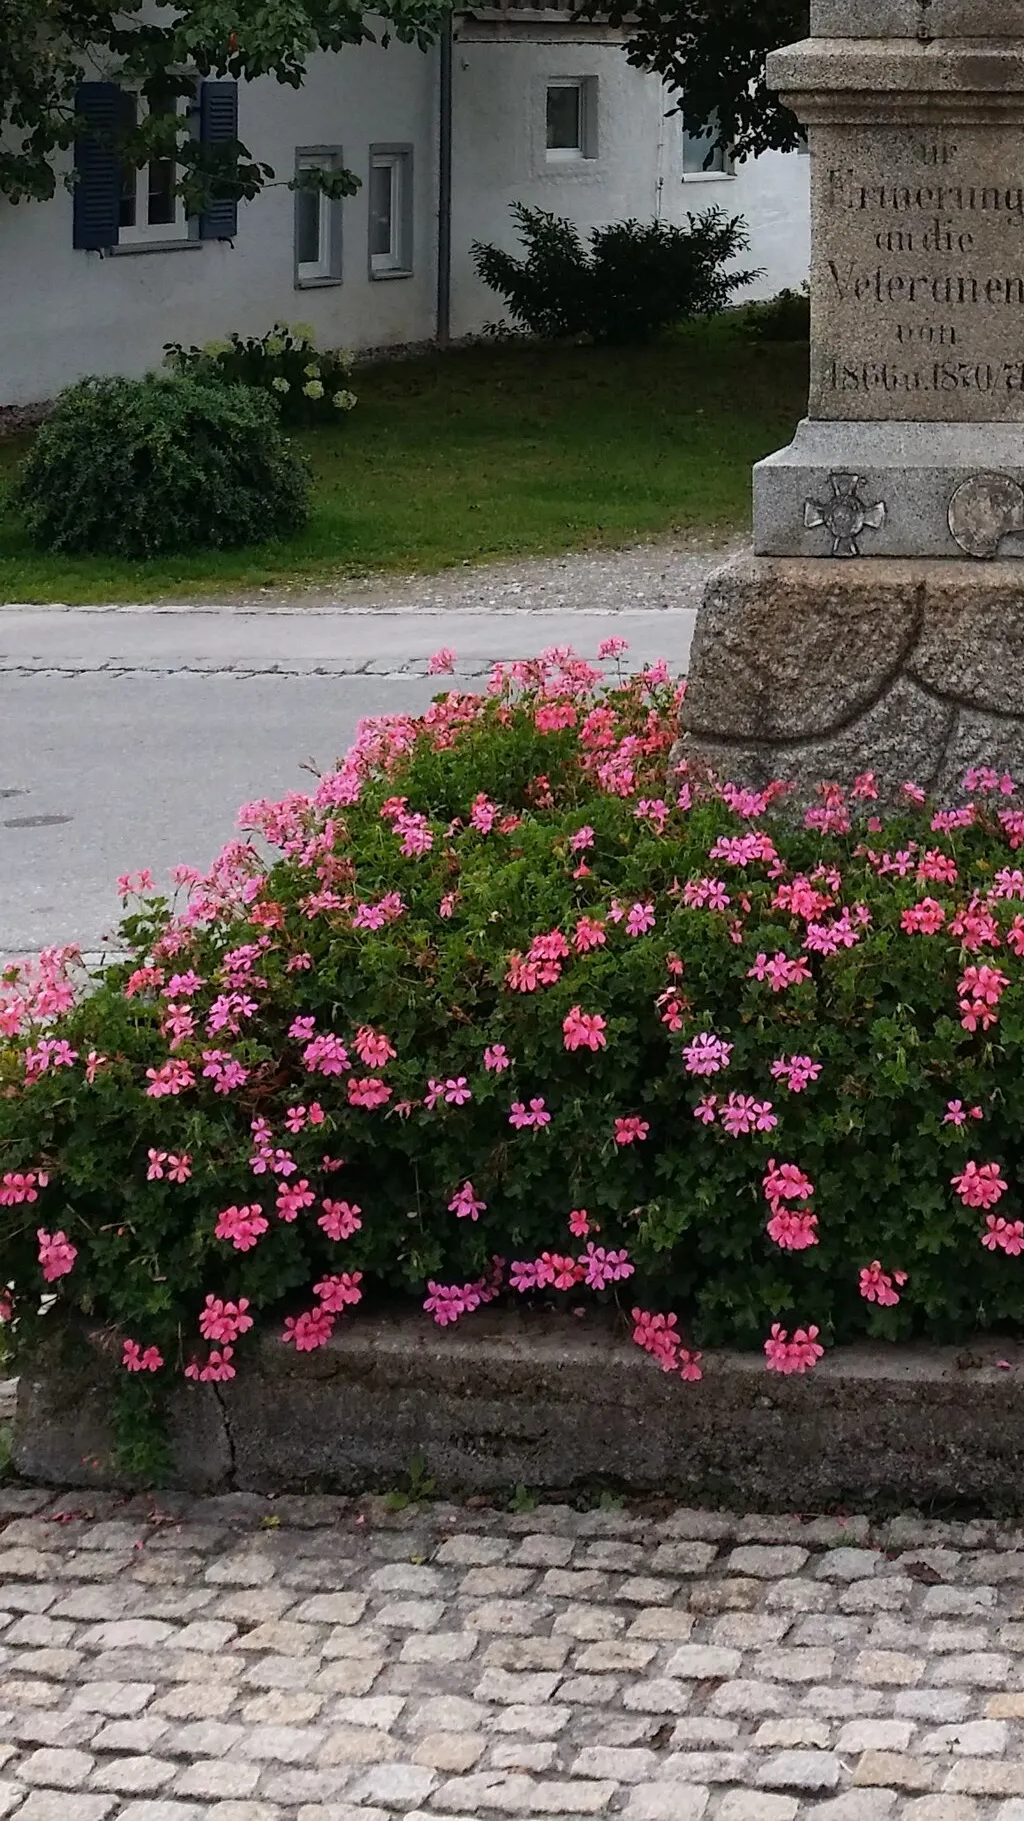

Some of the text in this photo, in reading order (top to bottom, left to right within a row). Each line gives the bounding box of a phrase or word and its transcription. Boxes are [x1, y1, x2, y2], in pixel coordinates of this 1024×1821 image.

[875, 218, 974, 253] an die
[827, 260, 1024, 305] Veteranen
[897, 324, 957, 345] von
